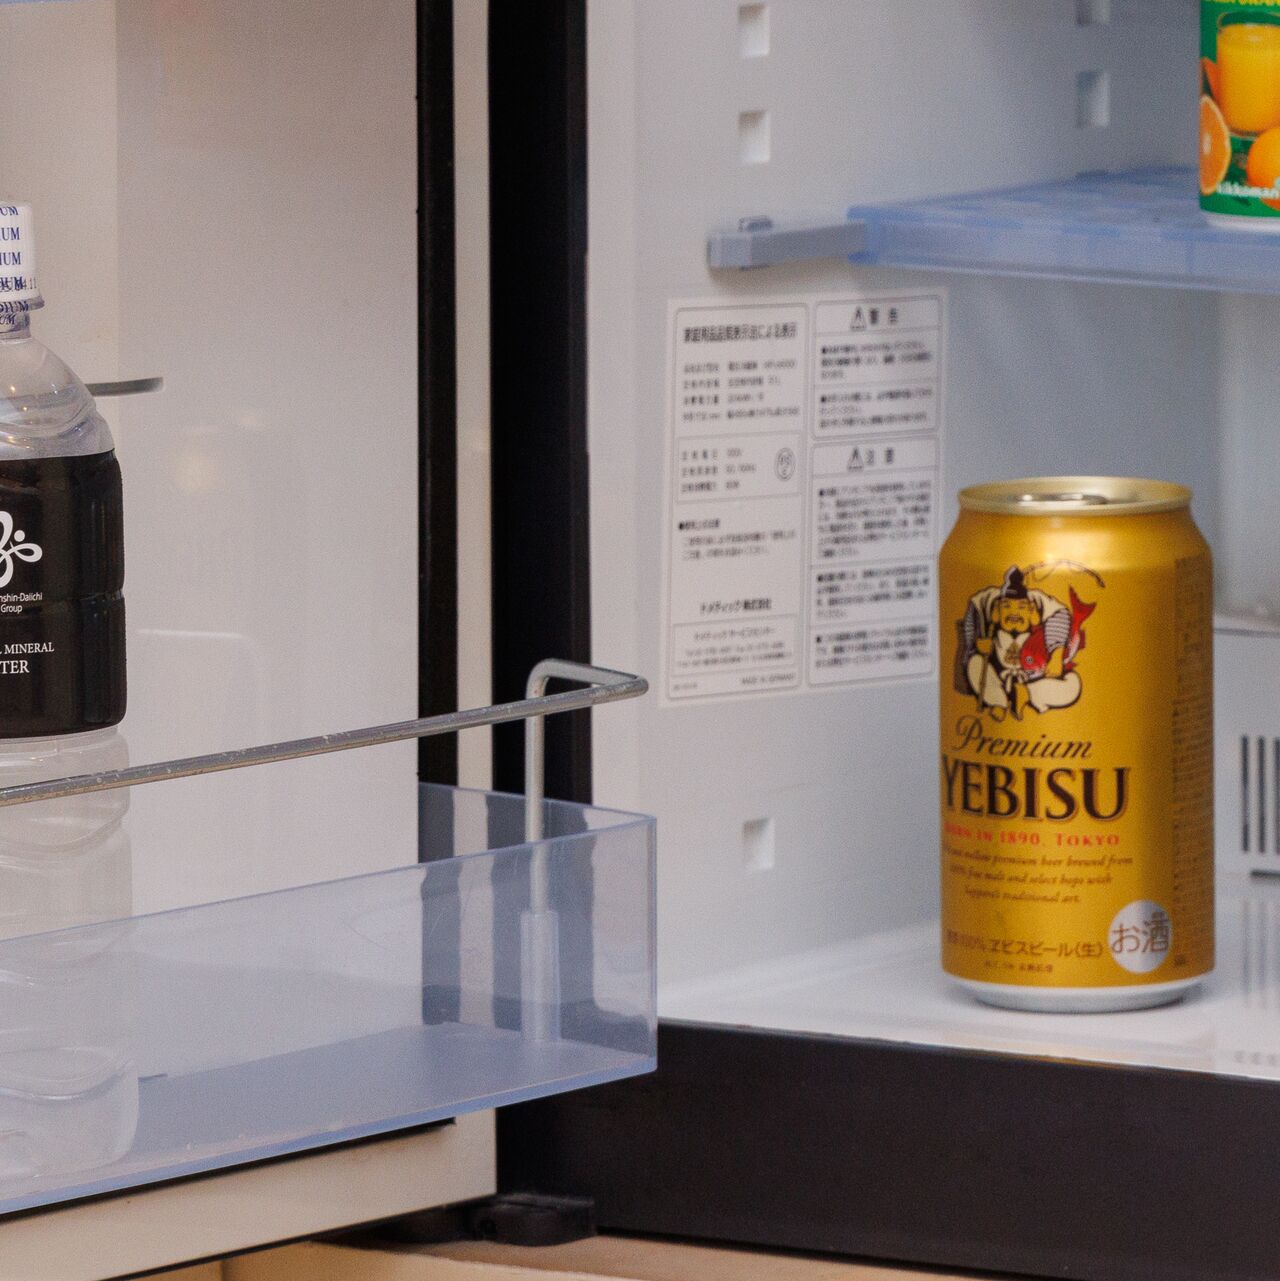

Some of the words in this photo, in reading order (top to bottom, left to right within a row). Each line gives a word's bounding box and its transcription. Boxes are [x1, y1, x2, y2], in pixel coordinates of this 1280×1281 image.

[1, 604, 23, 614] Group
[4, 642, 55, 654] MINERAL
[952, 714, 1094, 759] Premium
[941, 754, 1133, 821] YEBISU
